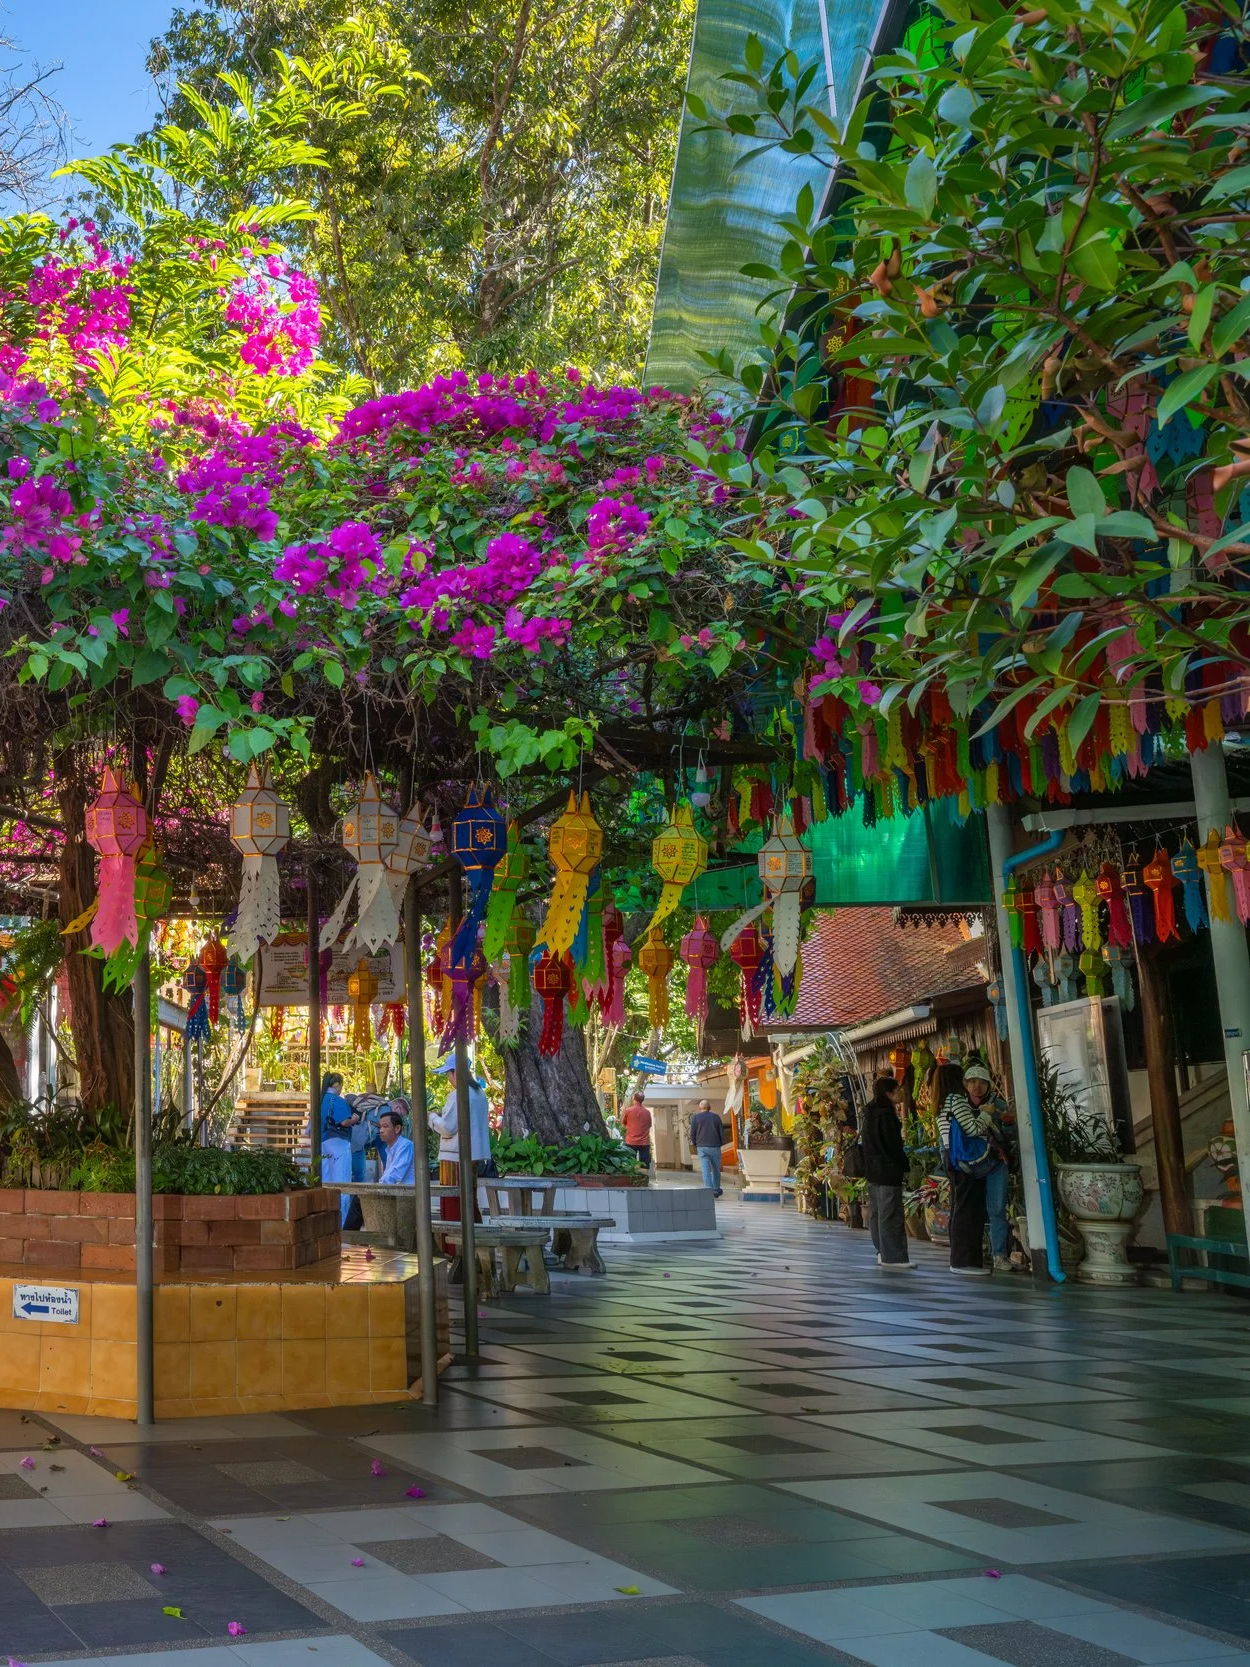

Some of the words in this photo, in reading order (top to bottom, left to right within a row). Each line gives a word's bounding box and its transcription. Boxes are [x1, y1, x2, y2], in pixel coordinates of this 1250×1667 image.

[19, 1291, 72, 1304] ทางไปห้องน้ำ
[51, 1307, 72, 1316] Toilet
